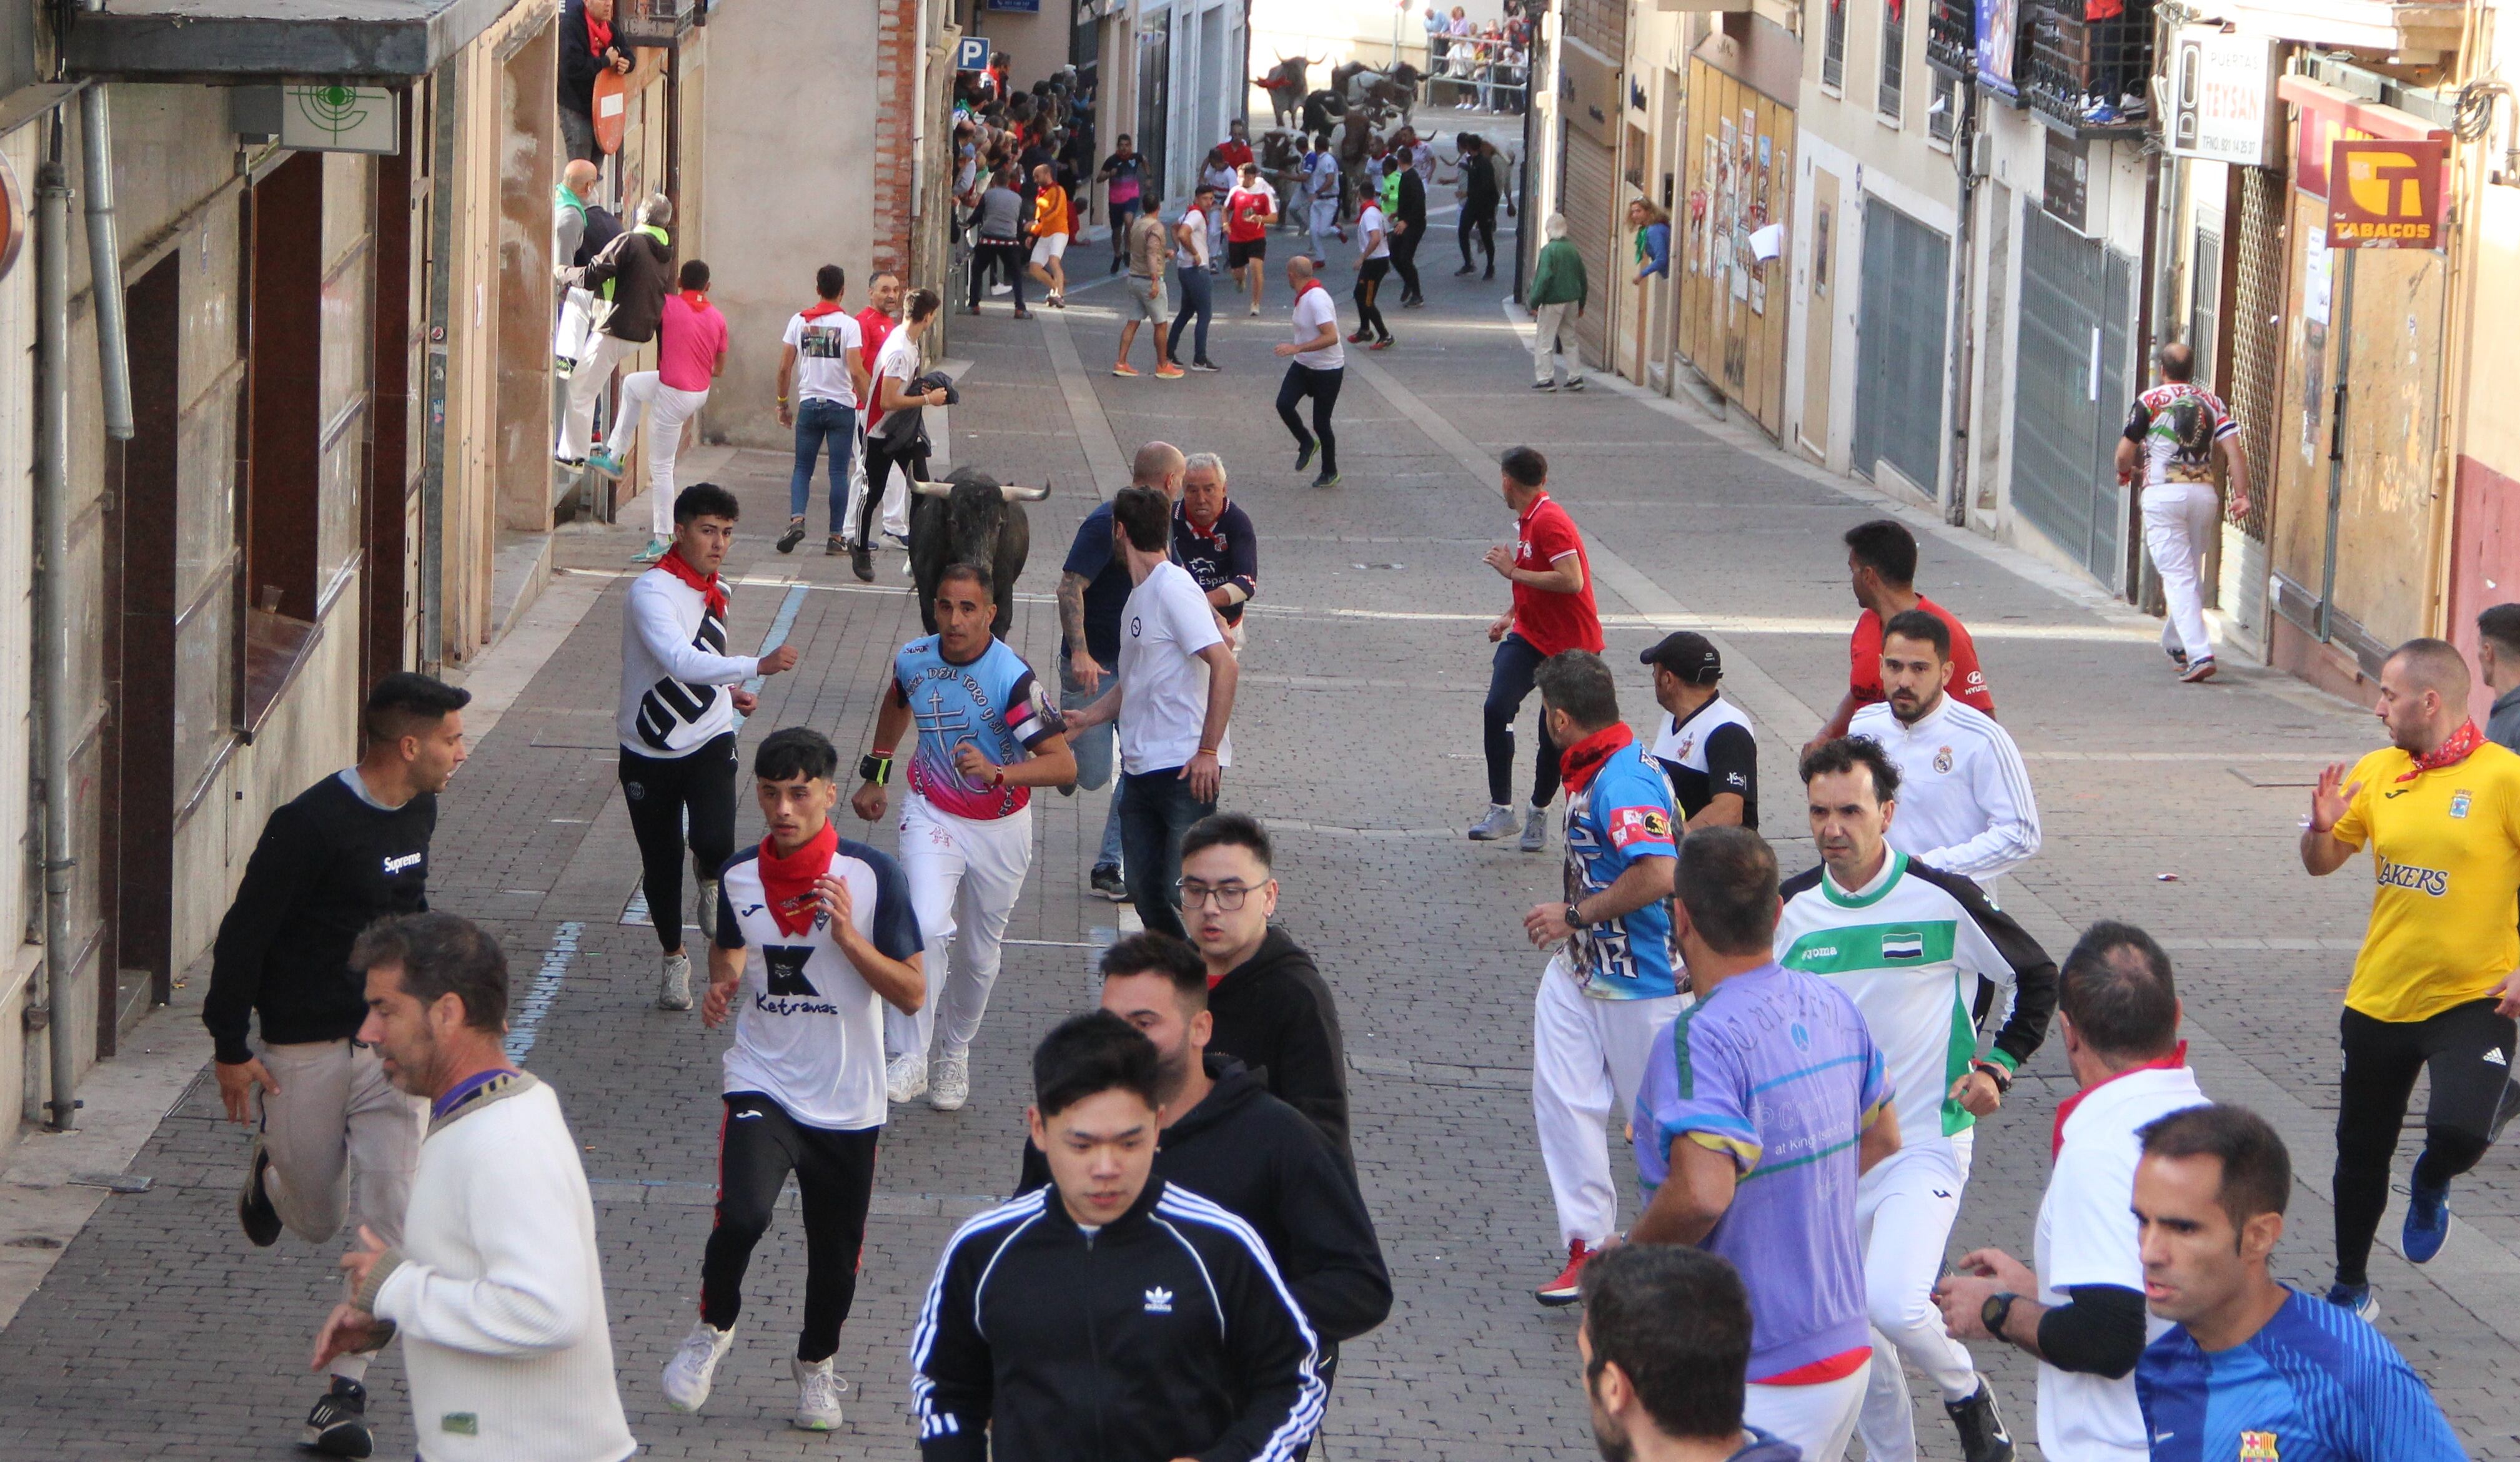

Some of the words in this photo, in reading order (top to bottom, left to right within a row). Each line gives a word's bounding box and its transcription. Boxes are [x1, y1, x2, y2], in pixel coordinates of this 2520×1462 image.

[963, 40, 983, 66] P
[2210, 51, 2259, 70] PUERTAS
[2205, 82, 2259, 121] TEYSAN
[2221, 137, 2231, 152] 921
[2233, 139, 2240, 153] 14
[2334, 222, 2431, 239] TABACOS
[927, 666, 958, 681] DEL
[963, 674, 988, 707] TORO
[384, 852, 422, 874] Supreme
[756, 991, 839, 1016] Ketranas
[2483, 1055, 2507, 1066] adidas
[1775, 1143, 1787, 1156] at
